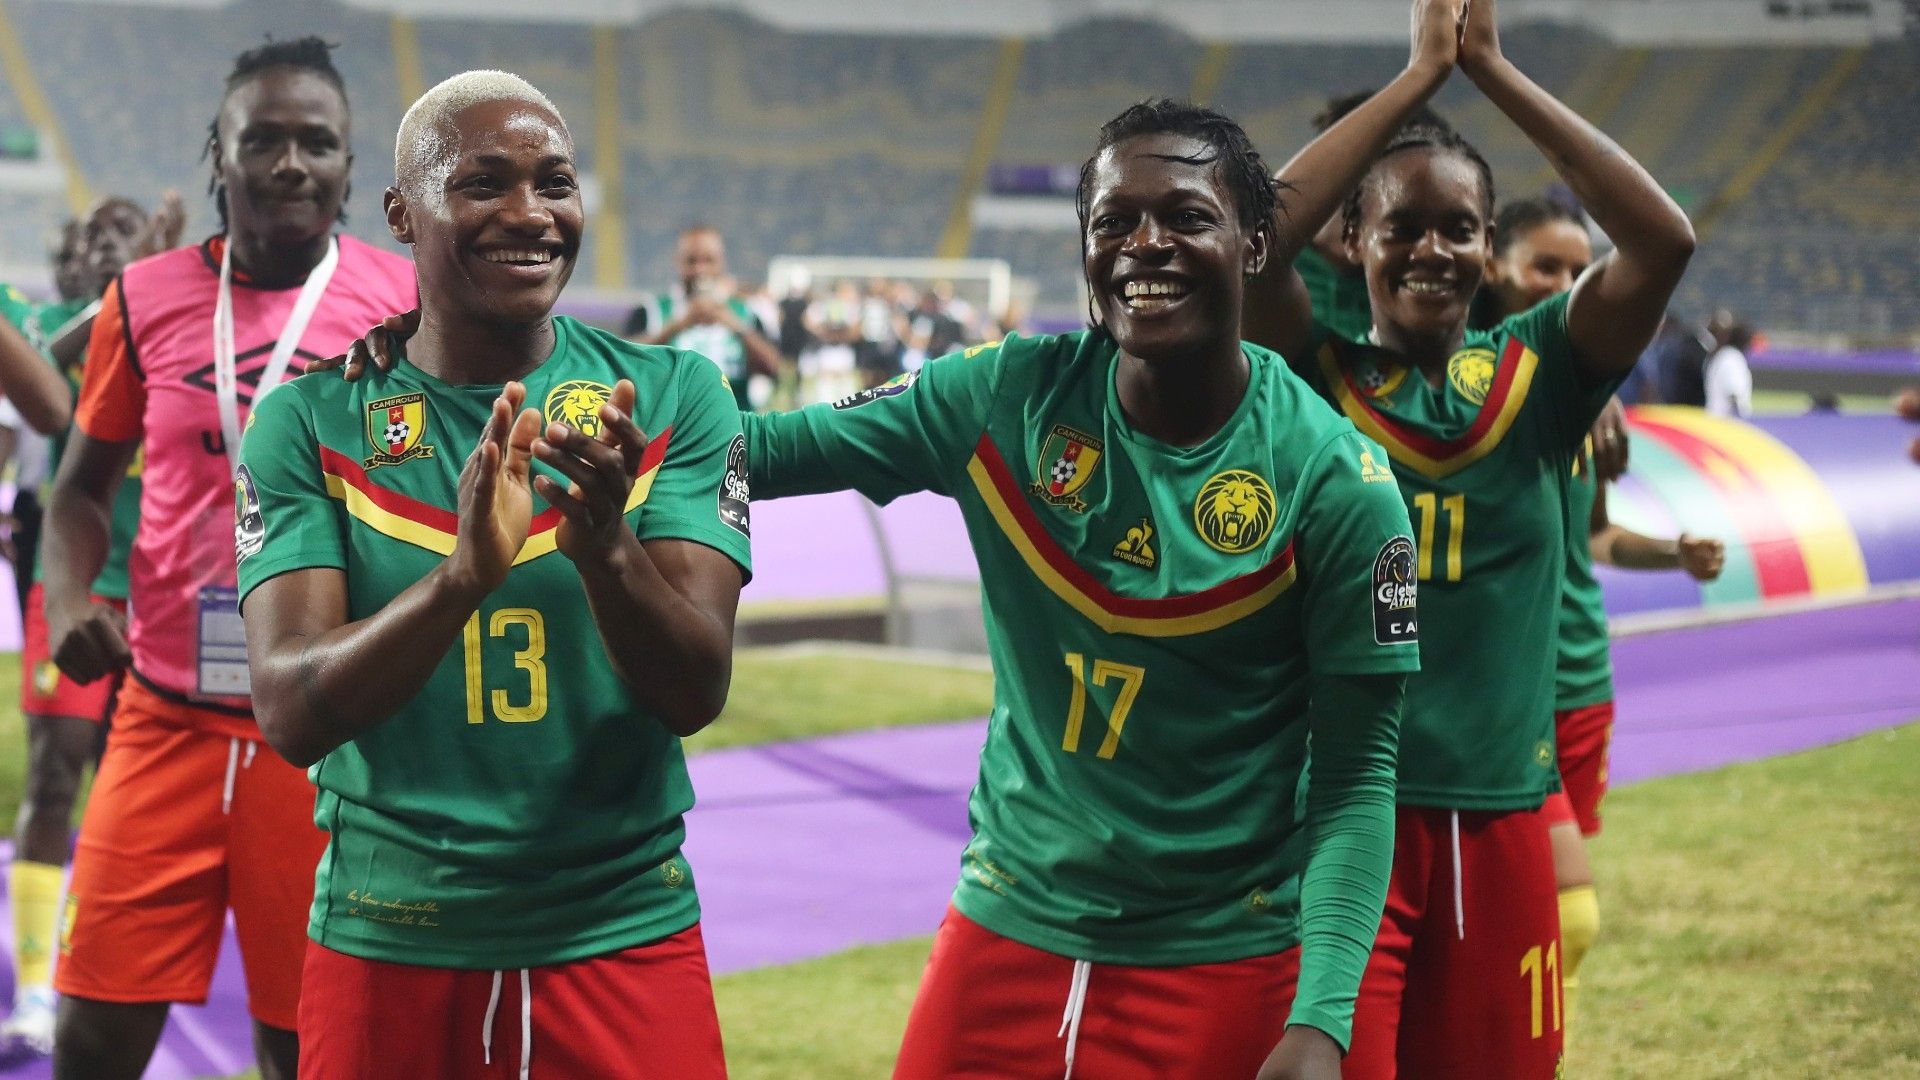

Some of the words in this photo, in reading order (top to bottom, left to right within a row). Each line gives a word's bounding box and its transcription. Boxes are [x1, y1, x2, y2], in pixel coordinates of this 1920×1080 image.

[372, 395, 420, 410] CAMEROUN
[1057, 428, 1102, 450] CAMEROUN
[1414, 491, 1465, 582] 11
[463, 607, 548, 724] 13
[1062, 652, 1146, 760] 17
[1519, 939, 1561, 1040] 11
